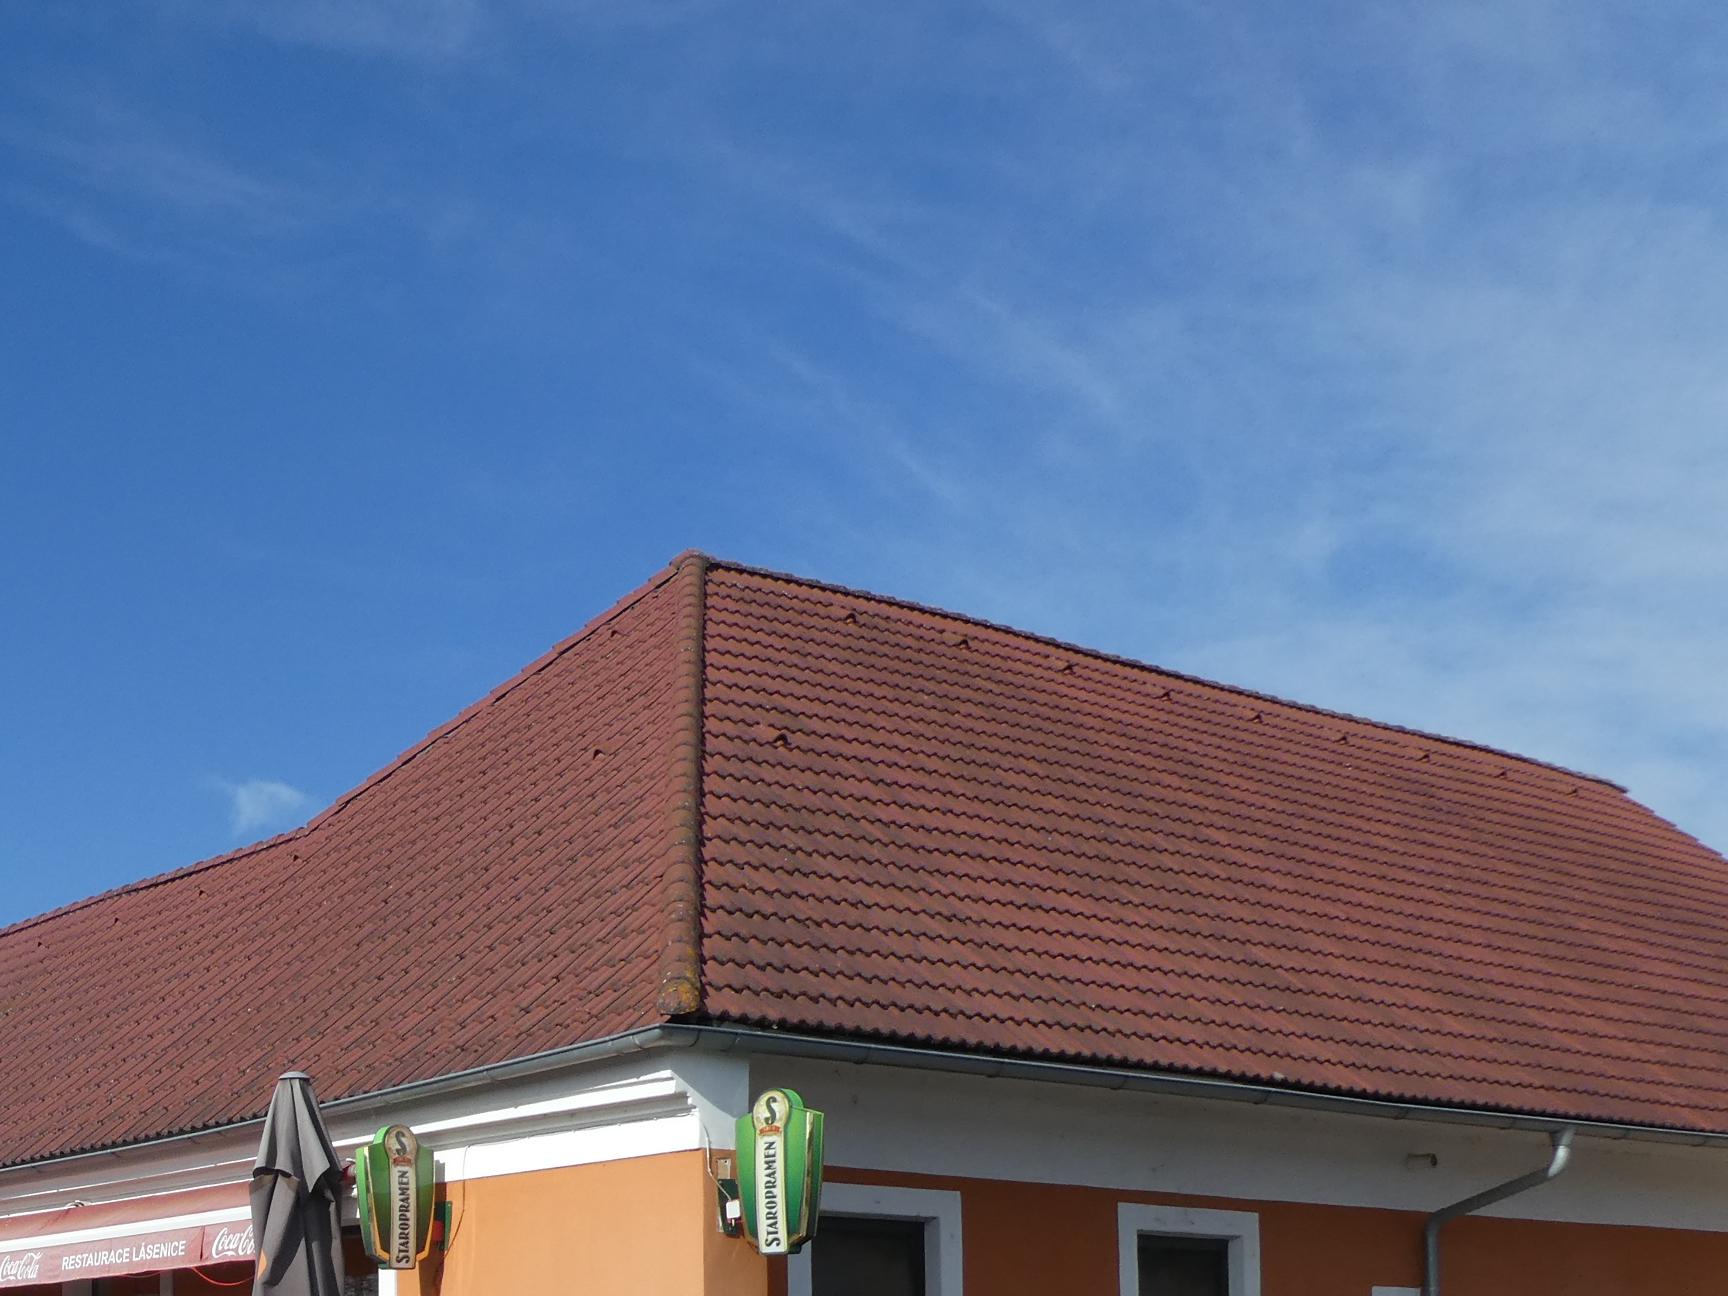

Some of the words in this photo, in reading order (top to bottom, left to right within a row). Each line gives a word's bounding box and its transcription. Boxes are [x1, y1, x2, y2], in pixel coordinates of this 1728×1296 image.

[396, 1170, 411, 1264] STAROPRAMEN
[763, 1141, 781, 1247] STAROPRAMEN
[62, 1247, 131, 1271] RESTAURACE
[132, 1240, 187, 1262] LÁSENICE
[212, 1224, 256, 1258] Coca-Co
